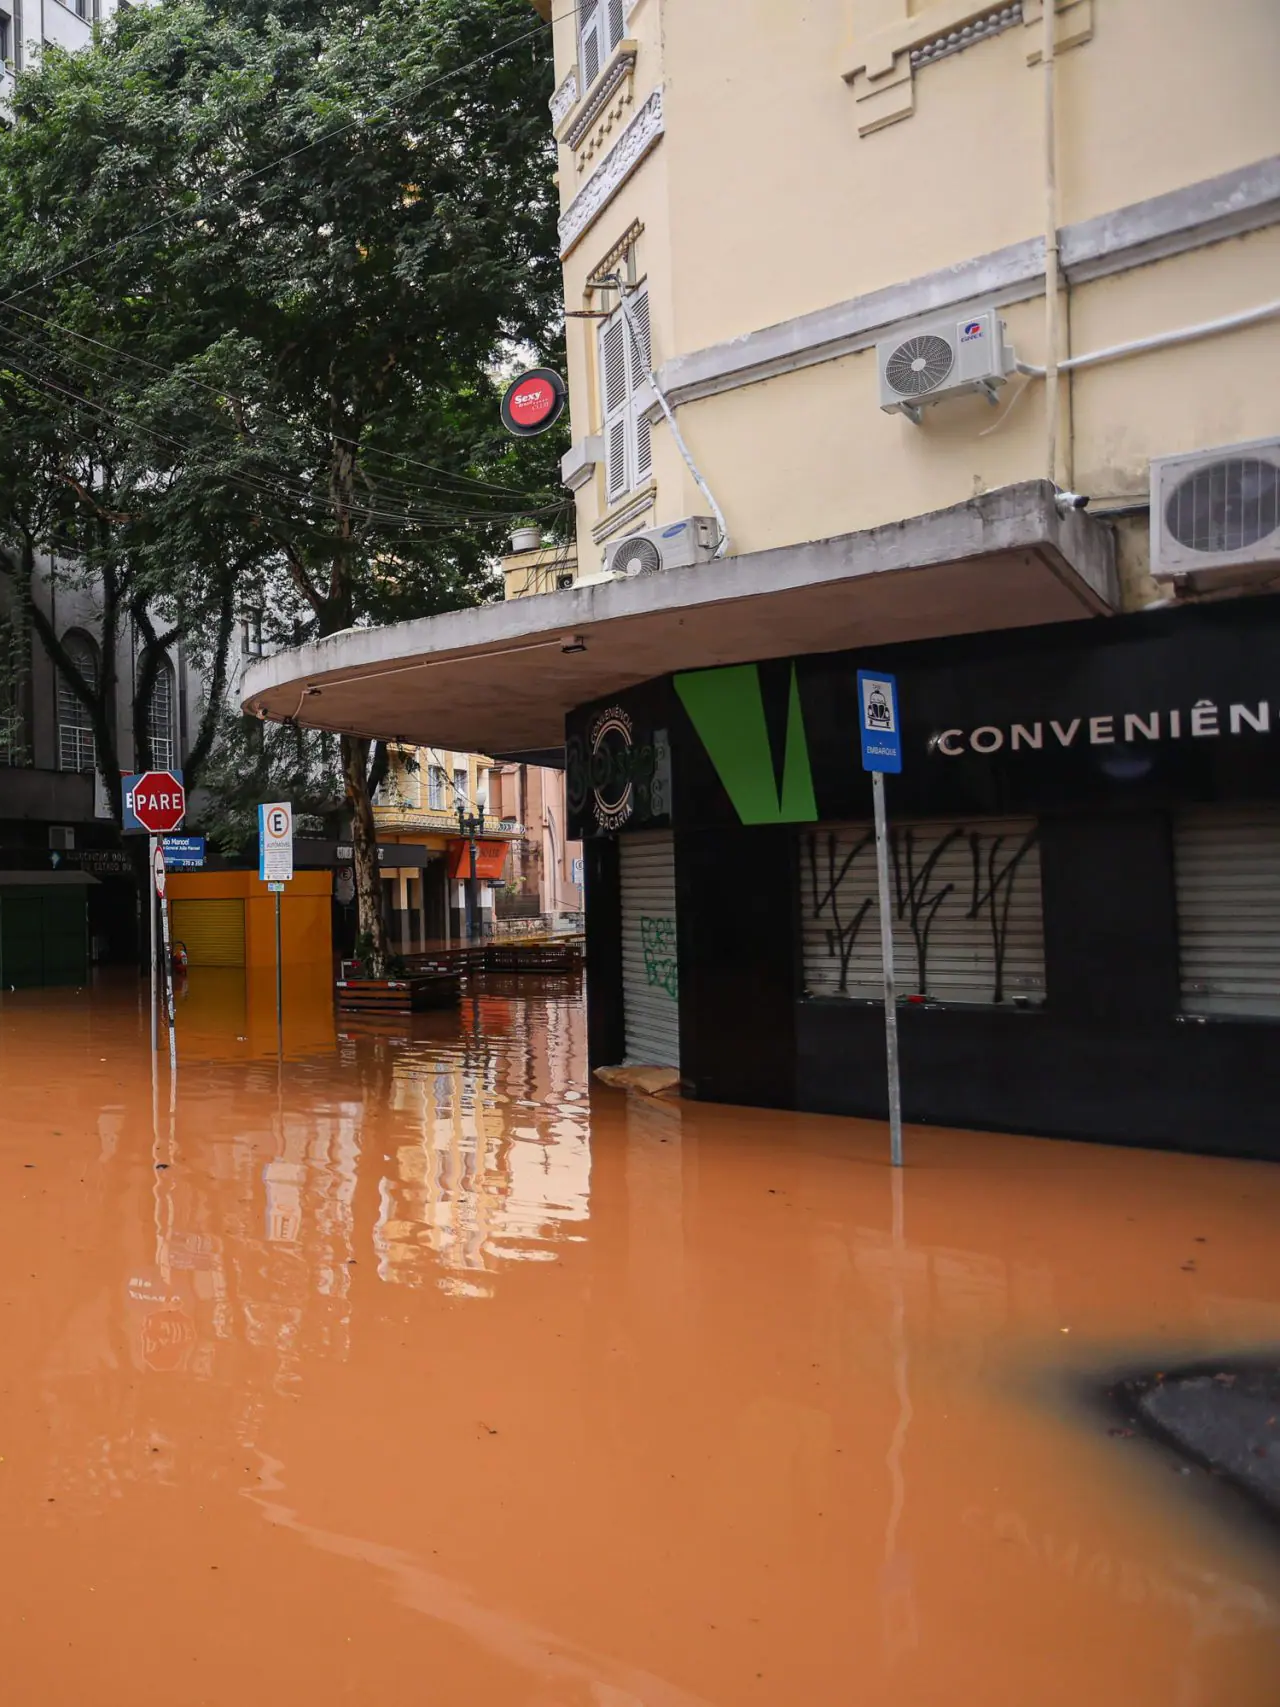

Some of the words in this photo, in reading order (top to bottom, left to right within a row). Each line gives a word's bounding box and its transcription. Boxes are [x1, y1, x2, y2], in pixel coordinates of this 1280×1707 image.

[514, 390, 542, 405] Sexy
[937, 699, 1280, 757] CONVENIÊN
[866, 745, 897, 756] EMBARQUE
[137, 792, 182, 811] PARE
[273, 814, 282, 831] E
[592, 802, 633, 830] TABACARIA
